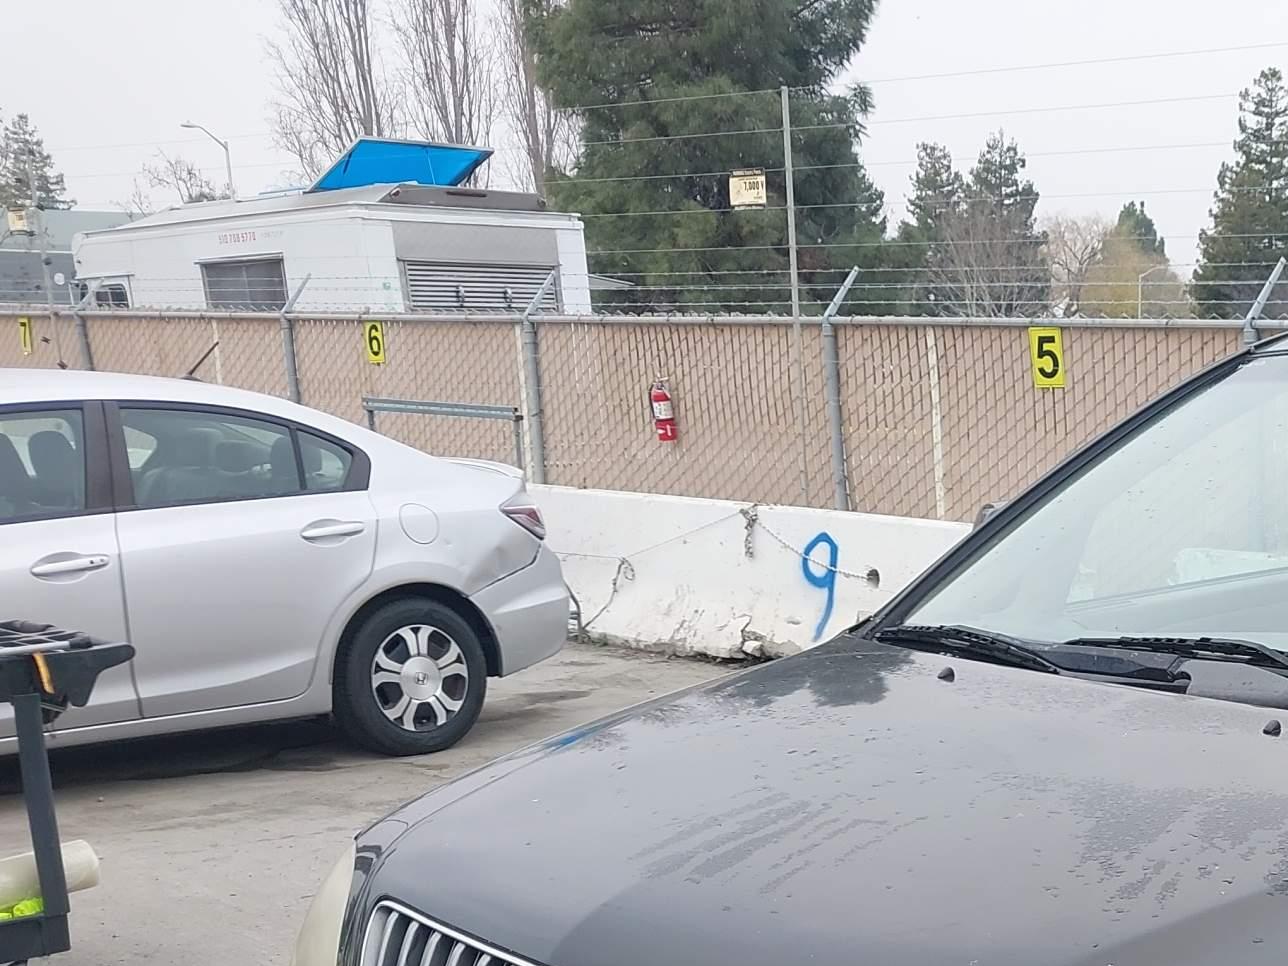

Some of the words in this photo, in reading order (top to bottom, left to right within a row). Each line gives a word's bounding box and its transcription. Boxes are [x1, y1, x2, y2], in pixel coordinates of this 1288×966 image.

[19, 321, 27, 348] 7
[368, 324, 381, 356] 6
[1037, 335, 1060, 379] 5
[802, 532, 838, 642] 9
